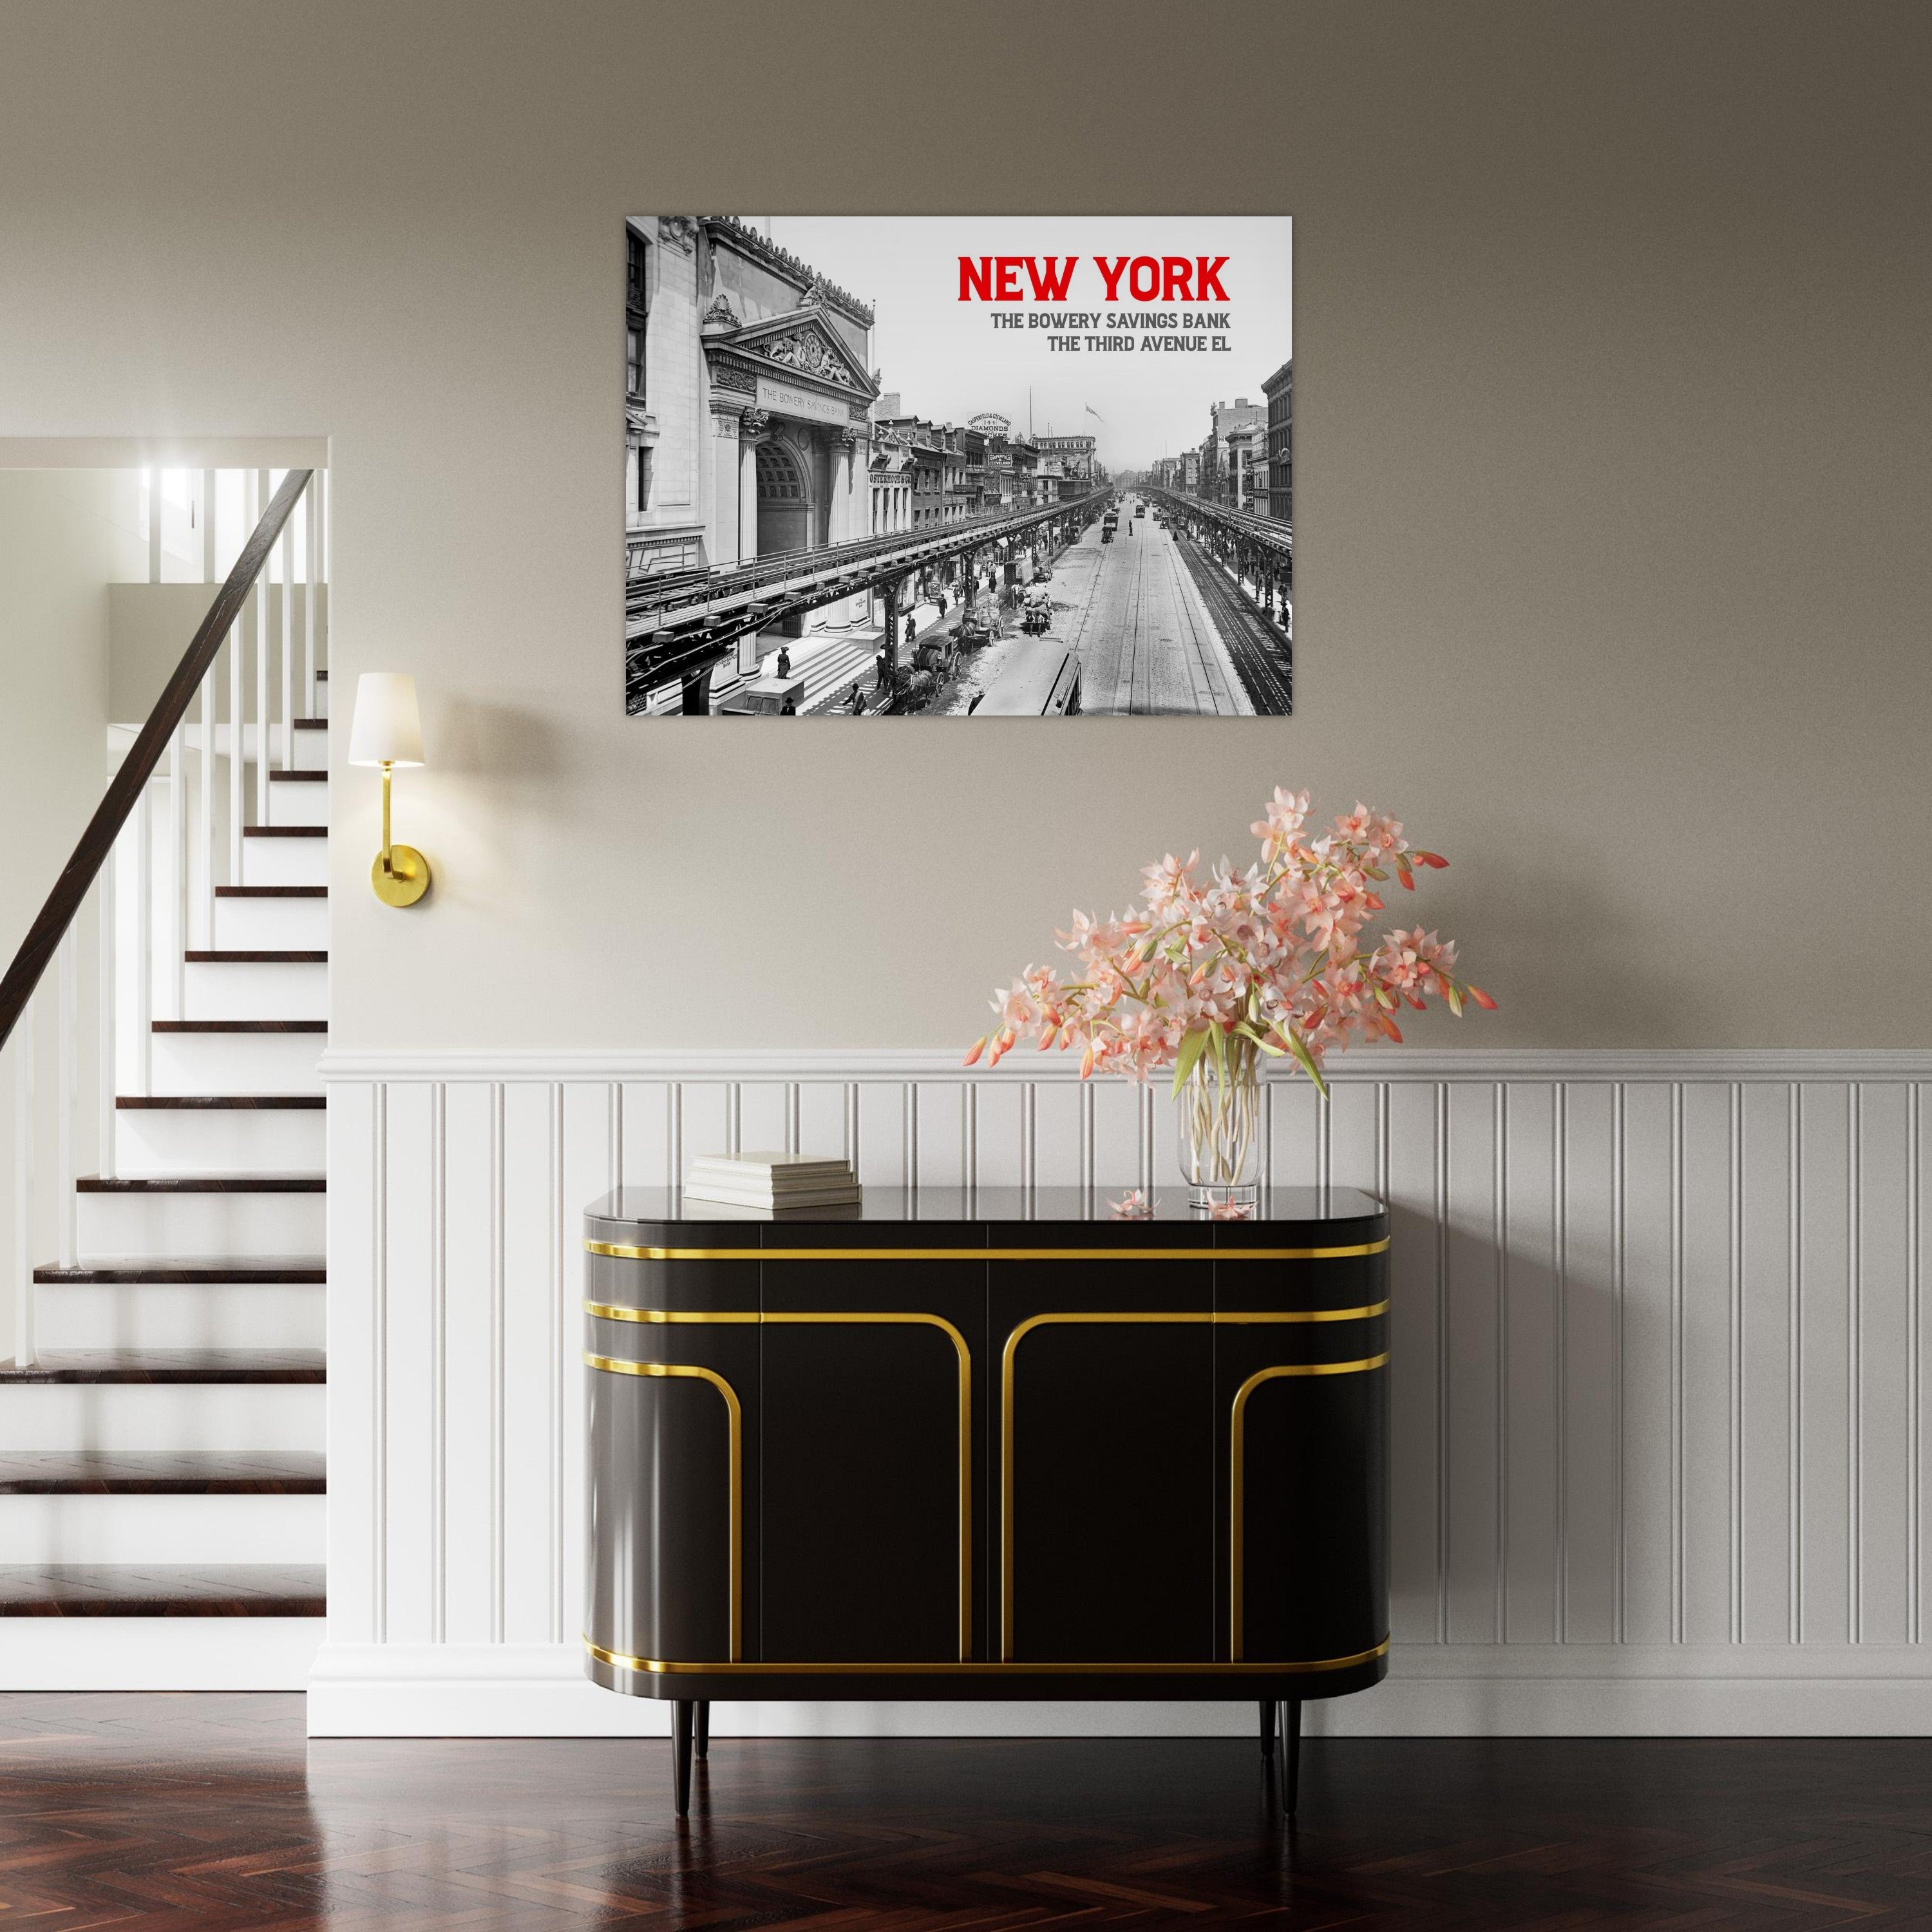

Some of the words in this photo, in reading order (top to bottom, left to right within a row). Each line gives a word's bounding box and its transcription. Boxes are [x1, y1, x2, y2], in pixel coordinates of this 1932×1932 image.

[958, 256, 1079, 301] NEW
[1093, 256, 1231, 302] YORK
[991, 313, 1024, 328] THE
[1028, 313, 1102, 328] BOWERY
[1106, 313, 1178, 328] SAVINGS
[1183, 313, 1231, 328] BANK
[1048, 336, 1081, 352] THE
[1084, 336, 1135, 352] THIRD
[1141, 336, 1208, 352] AVENUE
[1212, 336, 1231, 352] EL
[762, 388, 777, 401] THE
[780, 392, 806, 408] BOWERY
[807, 400, 830, 414] SAVINGS
[831, 406, 845, 417] BANK
